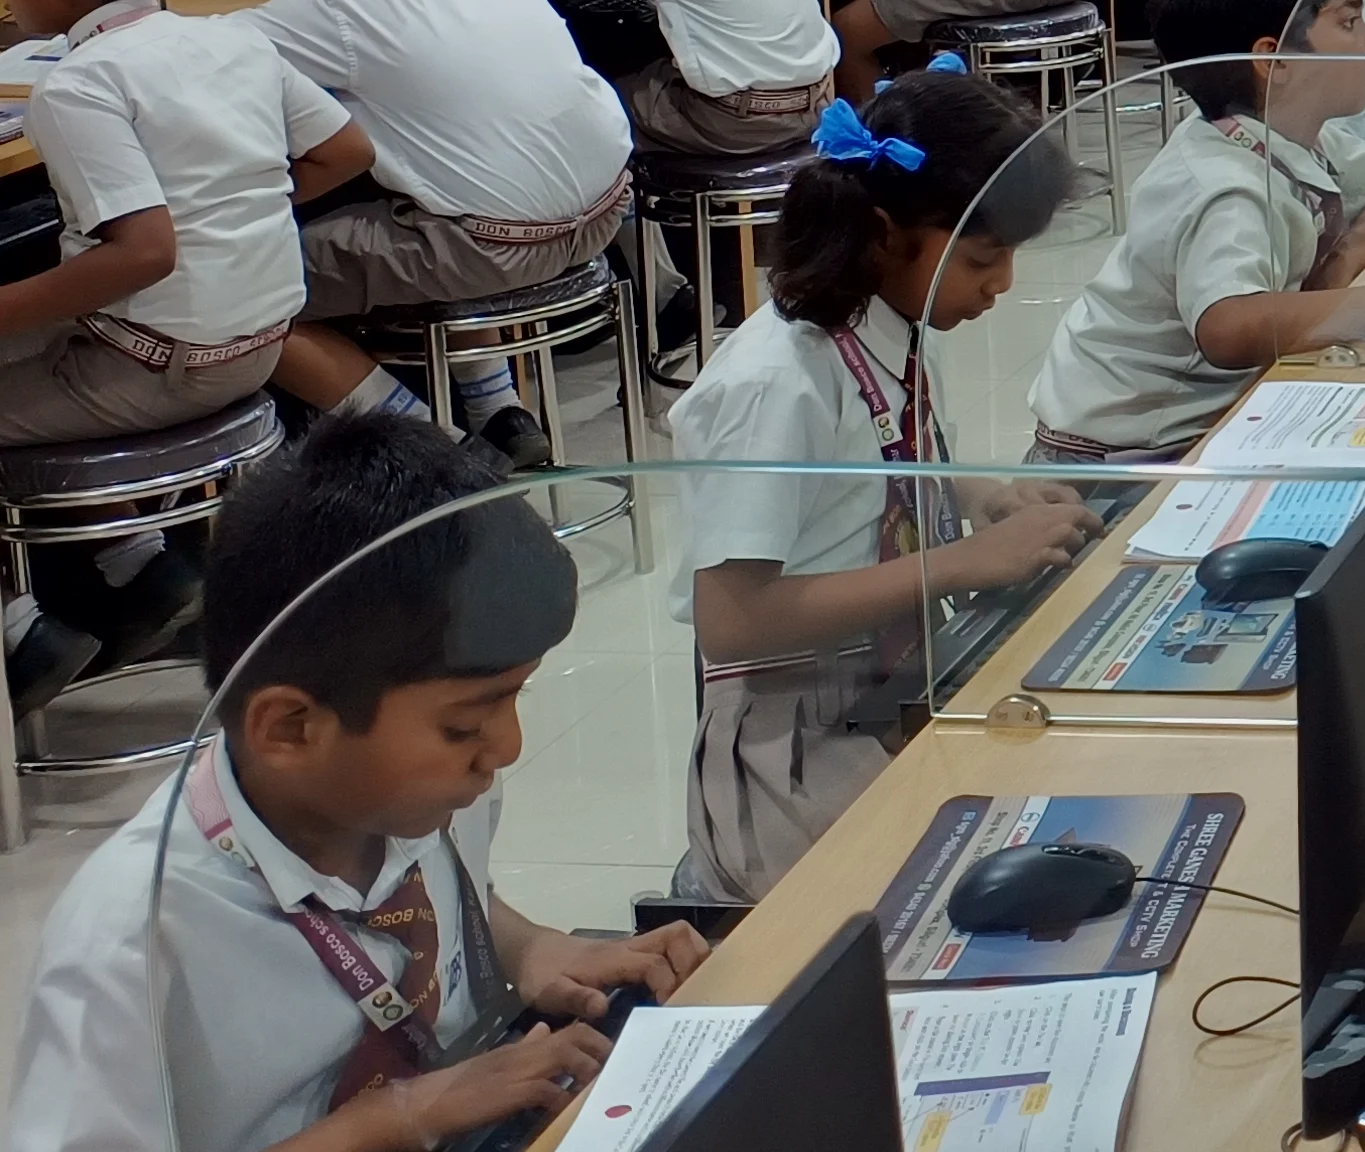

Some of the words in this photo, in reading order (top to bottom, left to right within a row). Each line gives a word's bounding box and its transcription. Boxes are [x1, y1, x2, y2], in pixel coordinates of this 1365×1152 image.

[475, 222, 511, 237] DON
[523, 225, 573, 238] BOSCO
[132, 339, 174, 365] DON
[186, 346, 241, 363] BOSCO
[1200, 813, 1225, 847] SHREE
[1141, 892, 1187, 959] MARKETING
[325, 934, 358, 972] Bosco
[352, 962, 375, 992] Don
